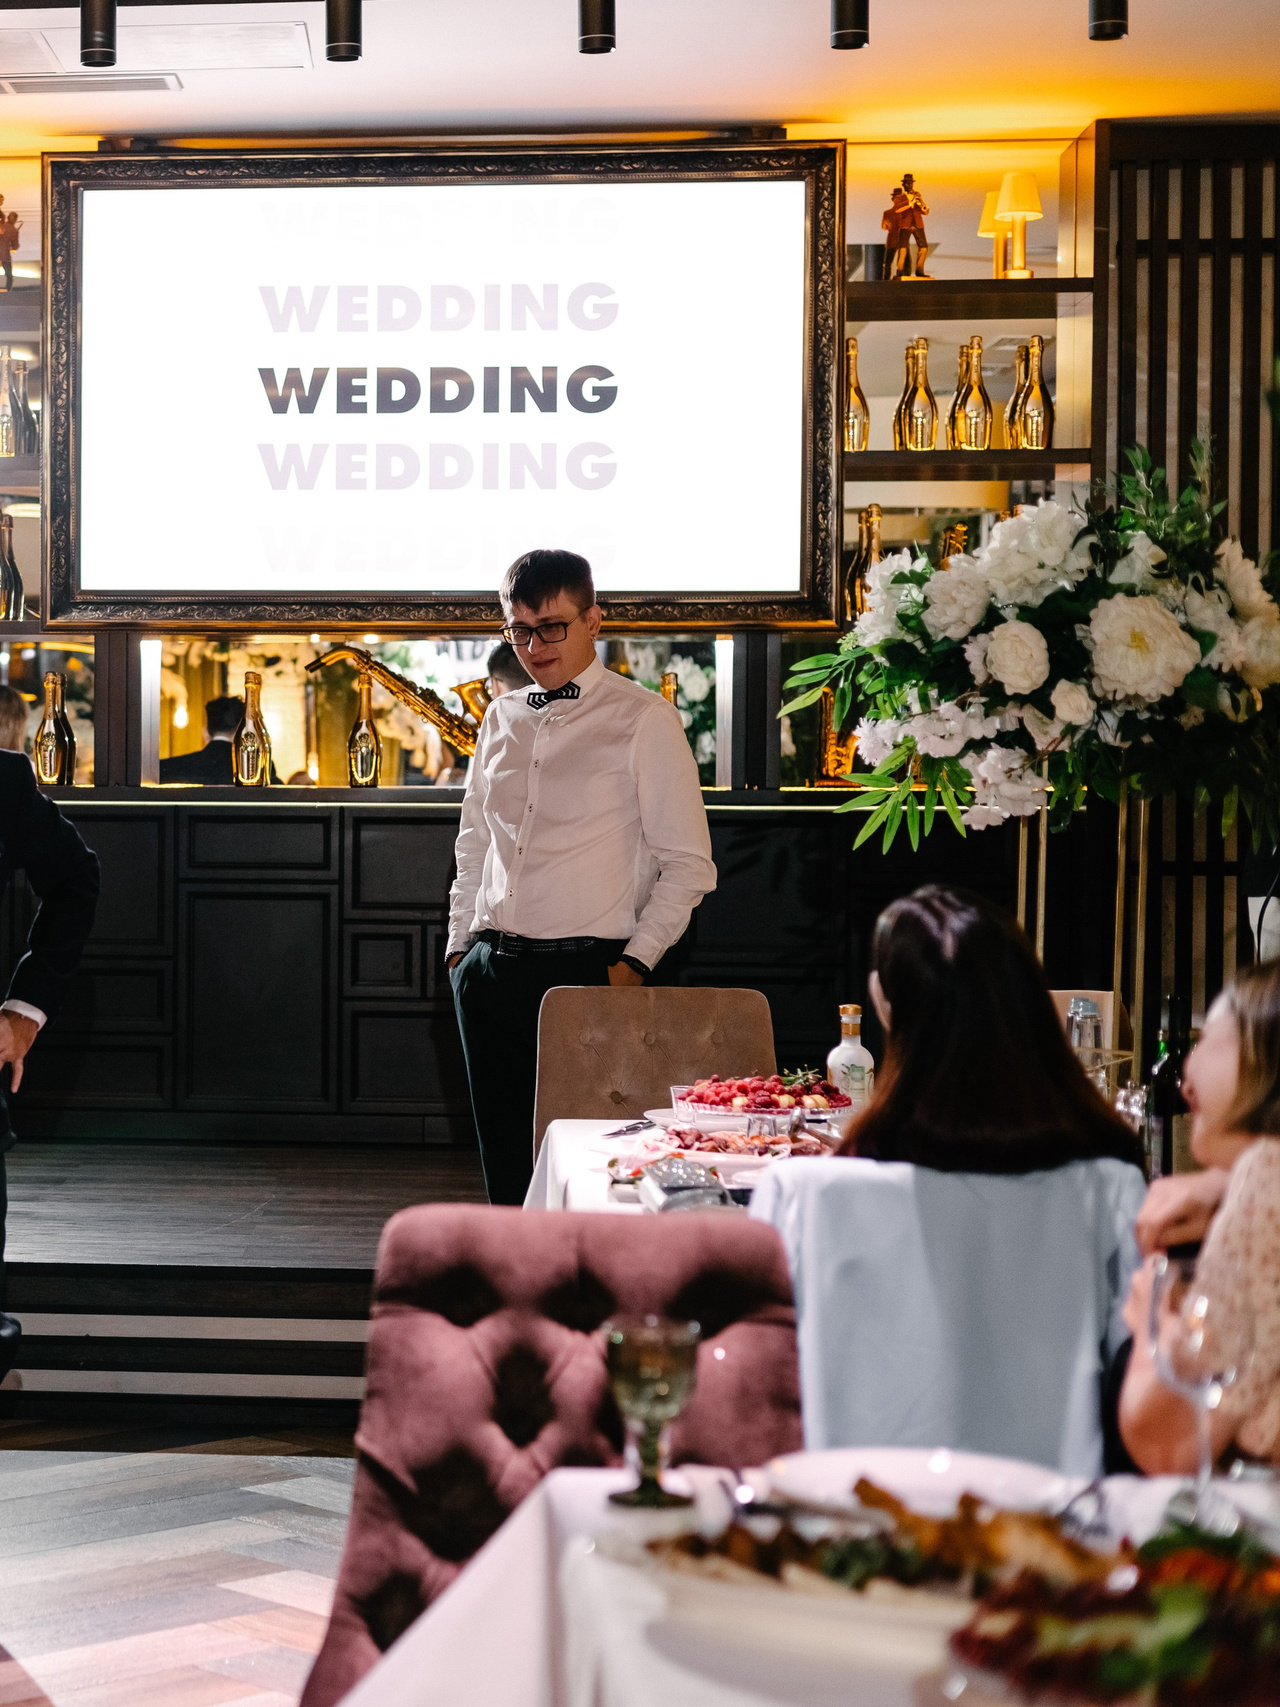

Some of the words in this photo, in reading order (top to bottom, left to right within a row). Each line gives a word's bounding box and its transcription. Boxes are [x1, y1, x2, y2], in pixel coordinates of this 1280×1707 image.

[258, 282, 620, 333] WEDDING
[257, 364, 619, 415] WEDDING
[257, 441, 618, 492] WEDDING
